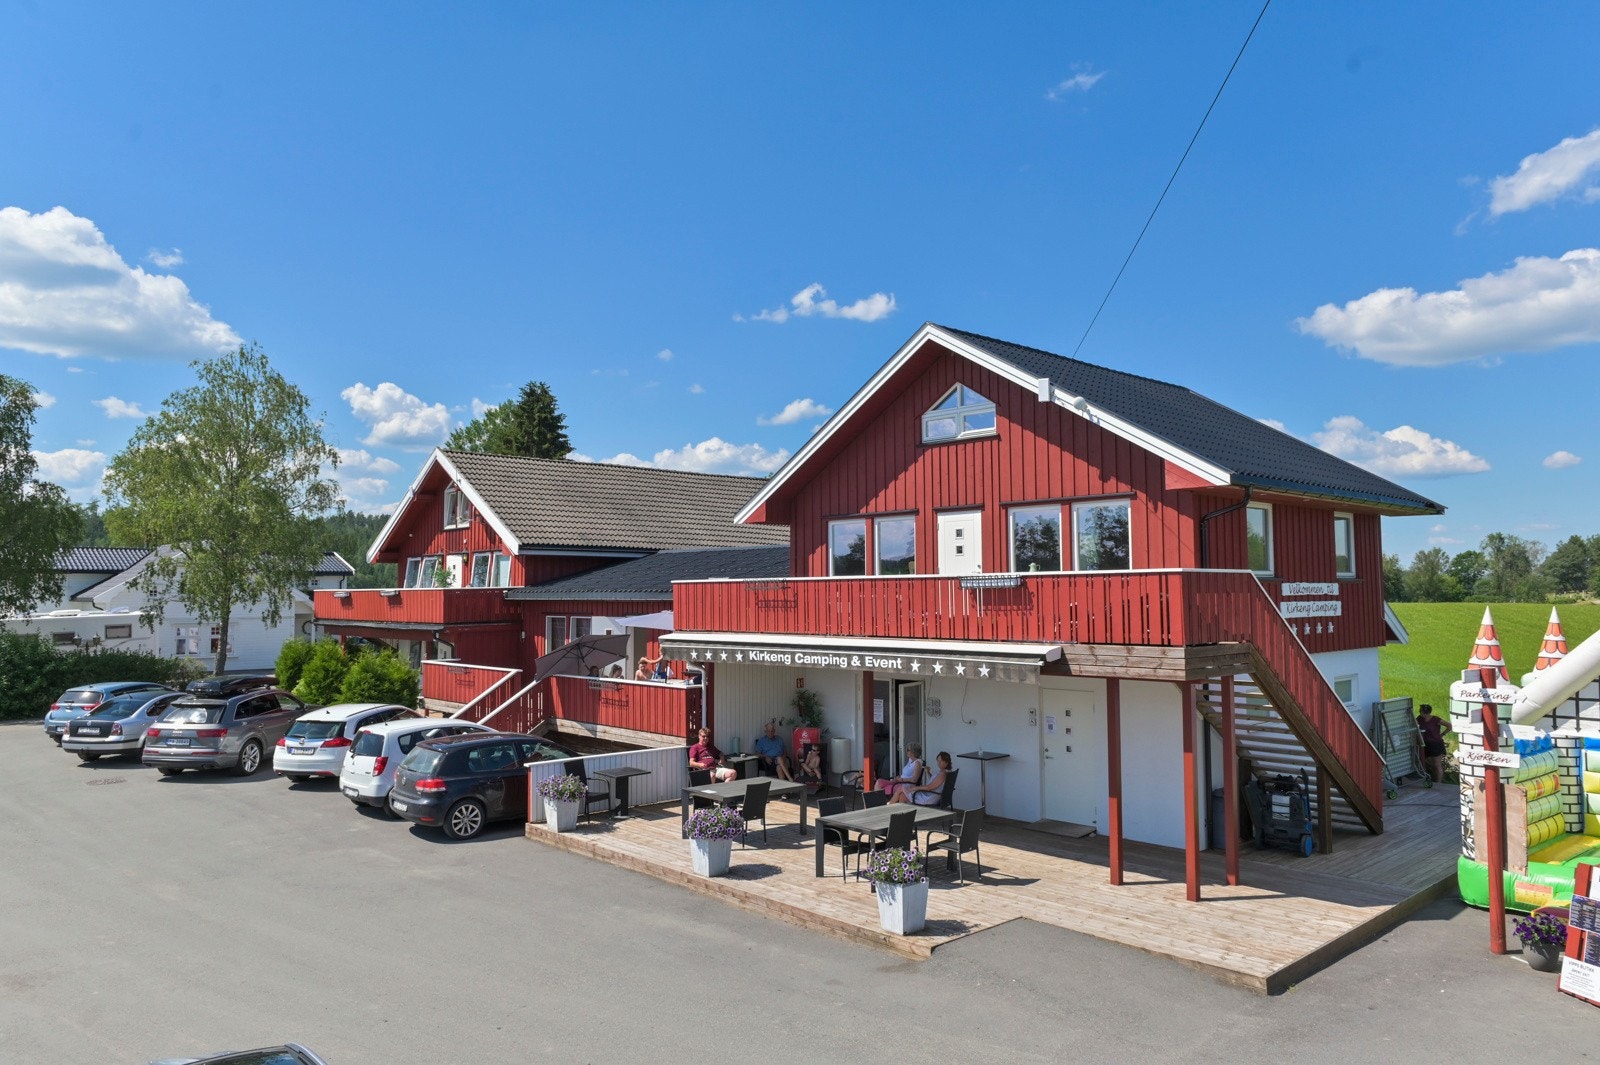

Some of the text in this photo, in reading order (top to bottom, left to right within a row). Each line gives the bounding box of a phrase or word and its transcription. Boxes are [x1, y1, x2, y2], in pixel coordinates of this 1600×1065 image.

[1286, 602, 1338, 616] Kirkeng Camping
[749, 650, 902, 669] Kirkeng Camping & Event
[1460, 690, 1512, 702] Parkering
